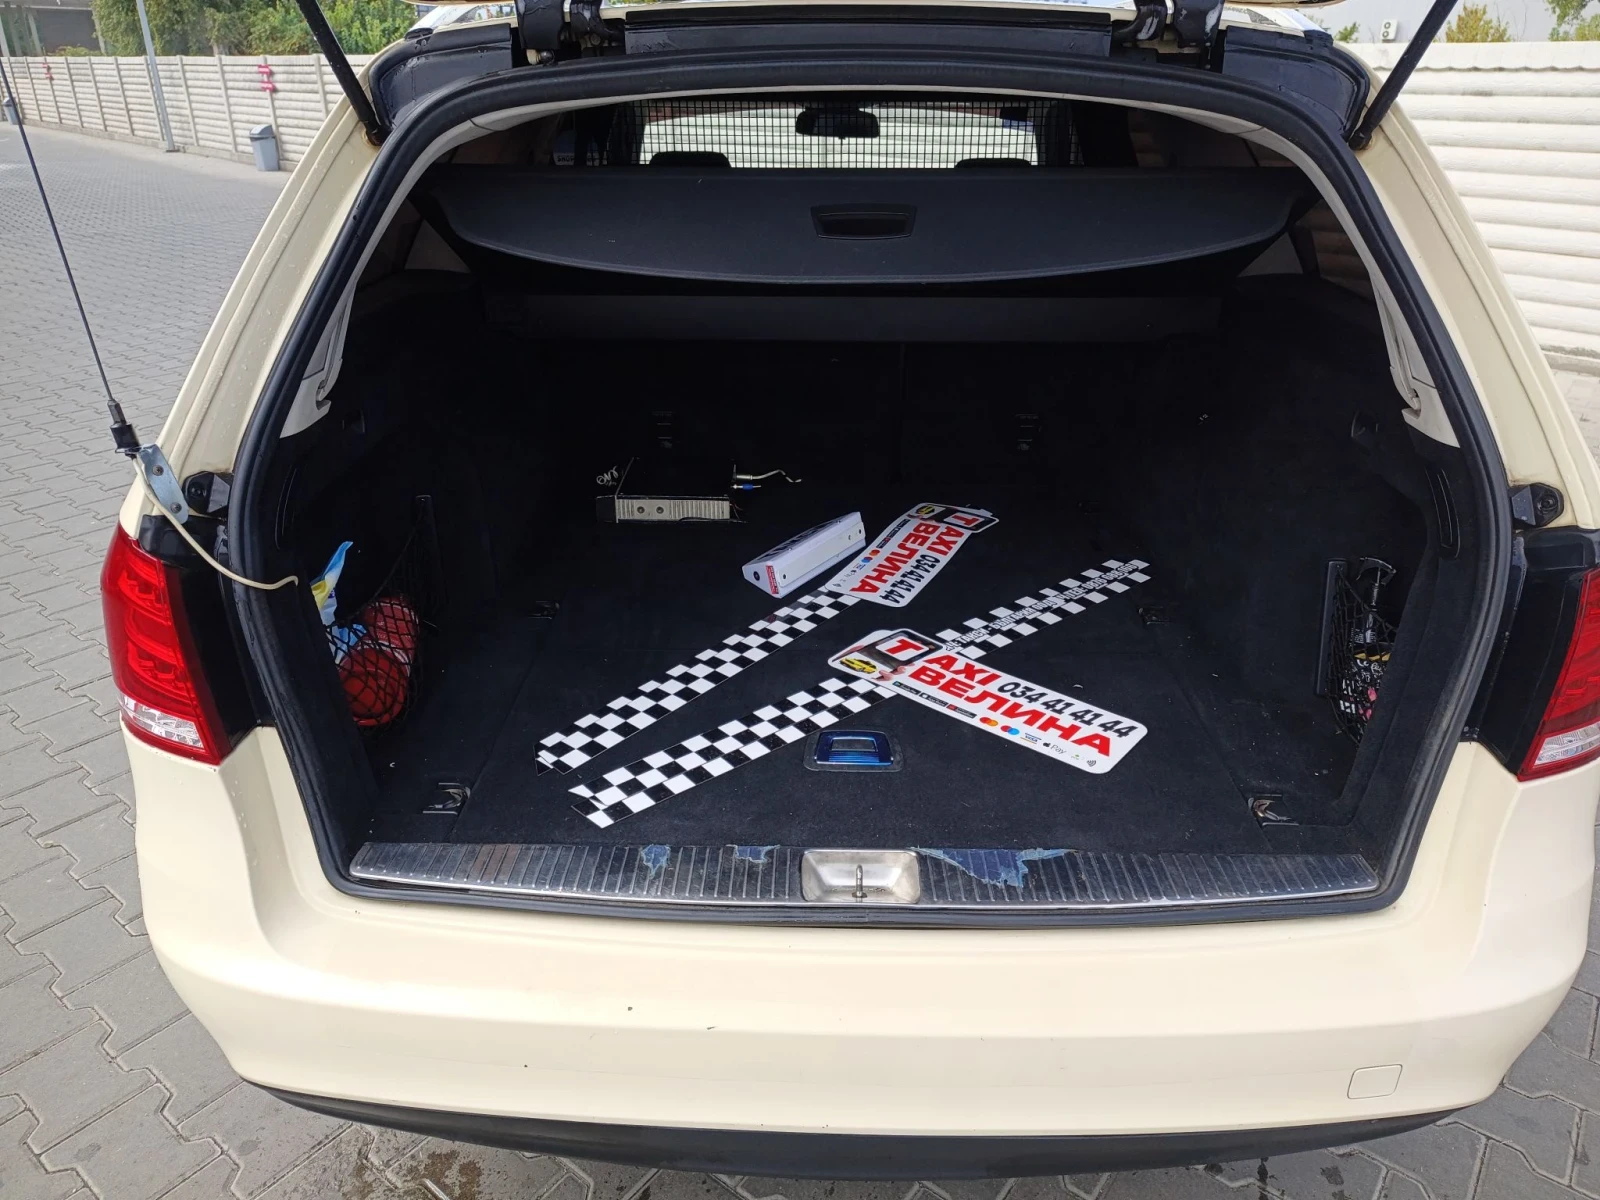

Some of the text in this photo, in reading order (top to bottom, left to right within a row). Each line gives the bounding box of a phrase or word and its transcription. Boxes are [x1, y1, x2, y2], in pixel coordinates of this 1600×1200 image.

[849, 522, 941, 594] ВЕЛИНА
[911, 554, 941, 574] 034
[900, 569, 926, 583] 41
[890, 579, 916, 593] 41
[879, 588, 906, 604] 44
[954, 627, 991, 644] ТАКСИ
[908, 665, 1111, 756] ВЕЛИНА
[997, 681, 1048, 704] 034
[1040, 698, 1075, 715] 41
[1068, 709, 1104, 726] 41
[1097, 720, 1138, 738] 44
[1050, 744, 1068, 755] Pay
